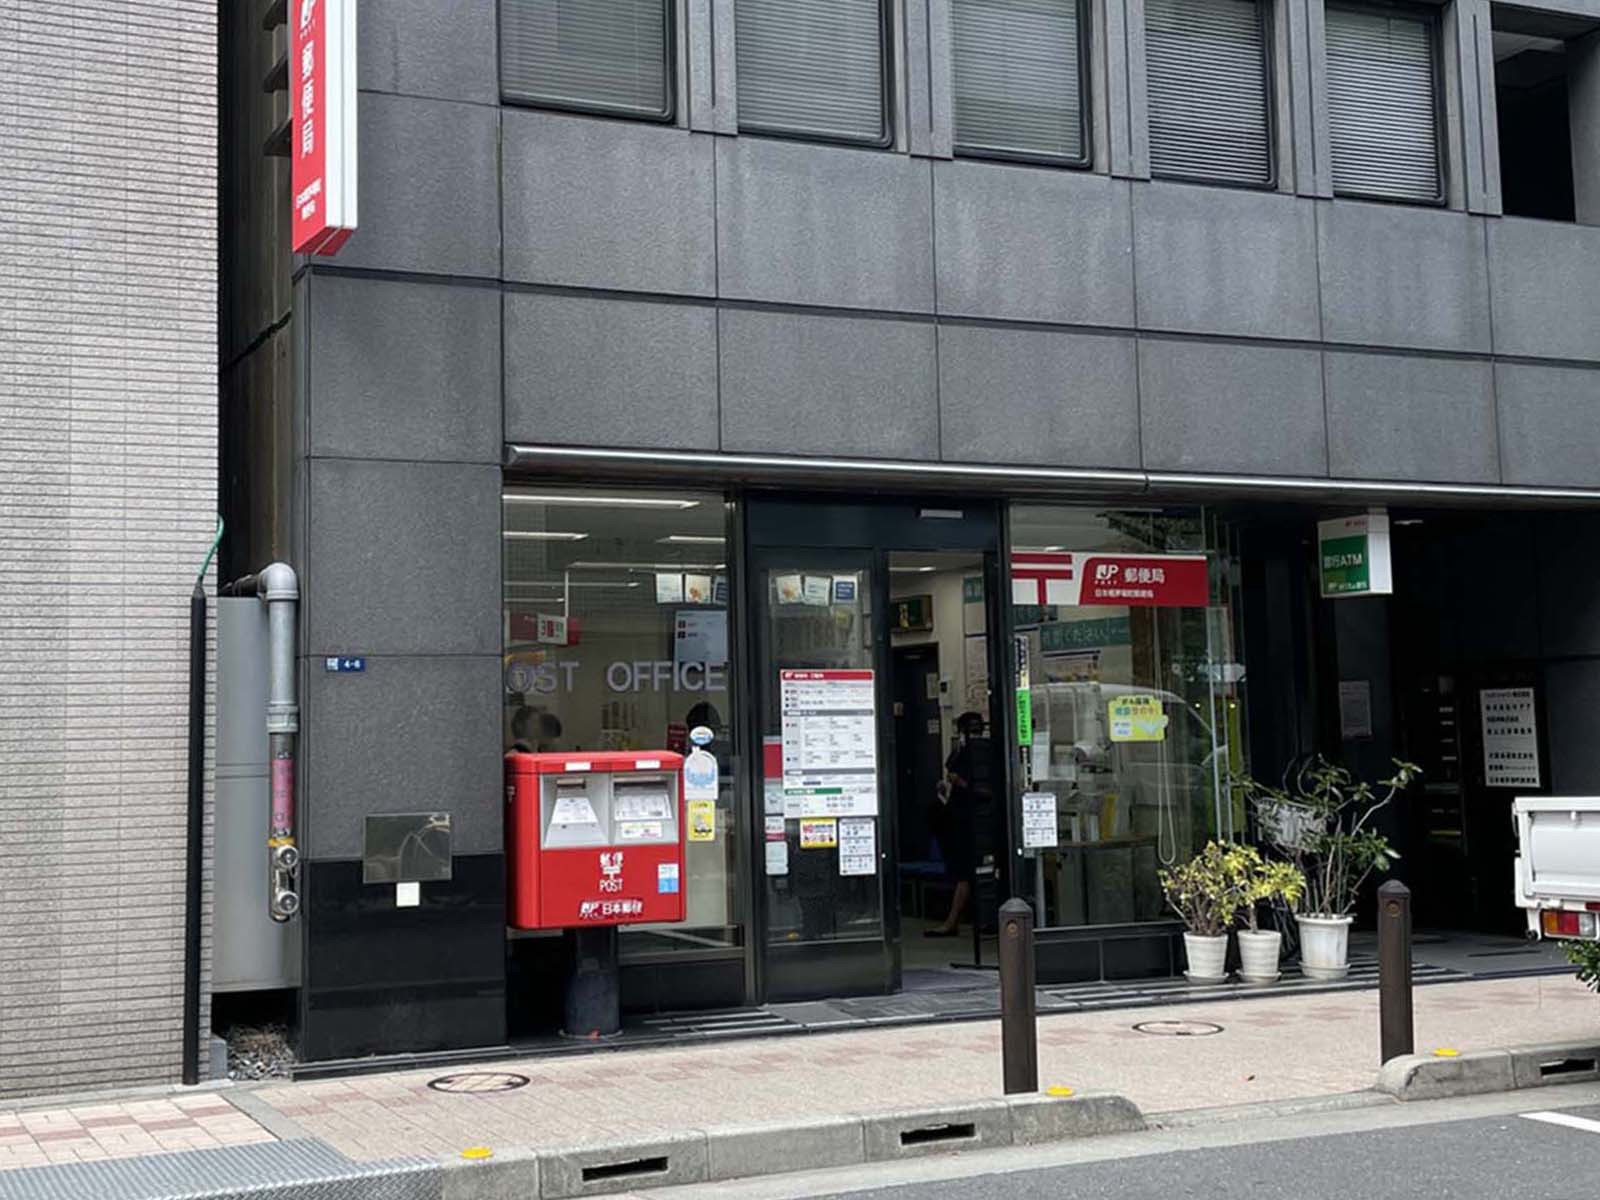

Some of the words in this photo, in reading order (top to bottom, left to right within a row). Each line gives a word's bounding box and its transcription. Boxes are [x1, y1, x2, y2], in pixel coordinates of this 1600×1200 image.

[1124, 568, 1165, 584] 郵便局
[607, 661, 727, 692] OFFICE
[600, 852, 624, 866] 郵便
[600, 878, 624, 893] POST
[603, 900, 643, 915] 日本郵便
